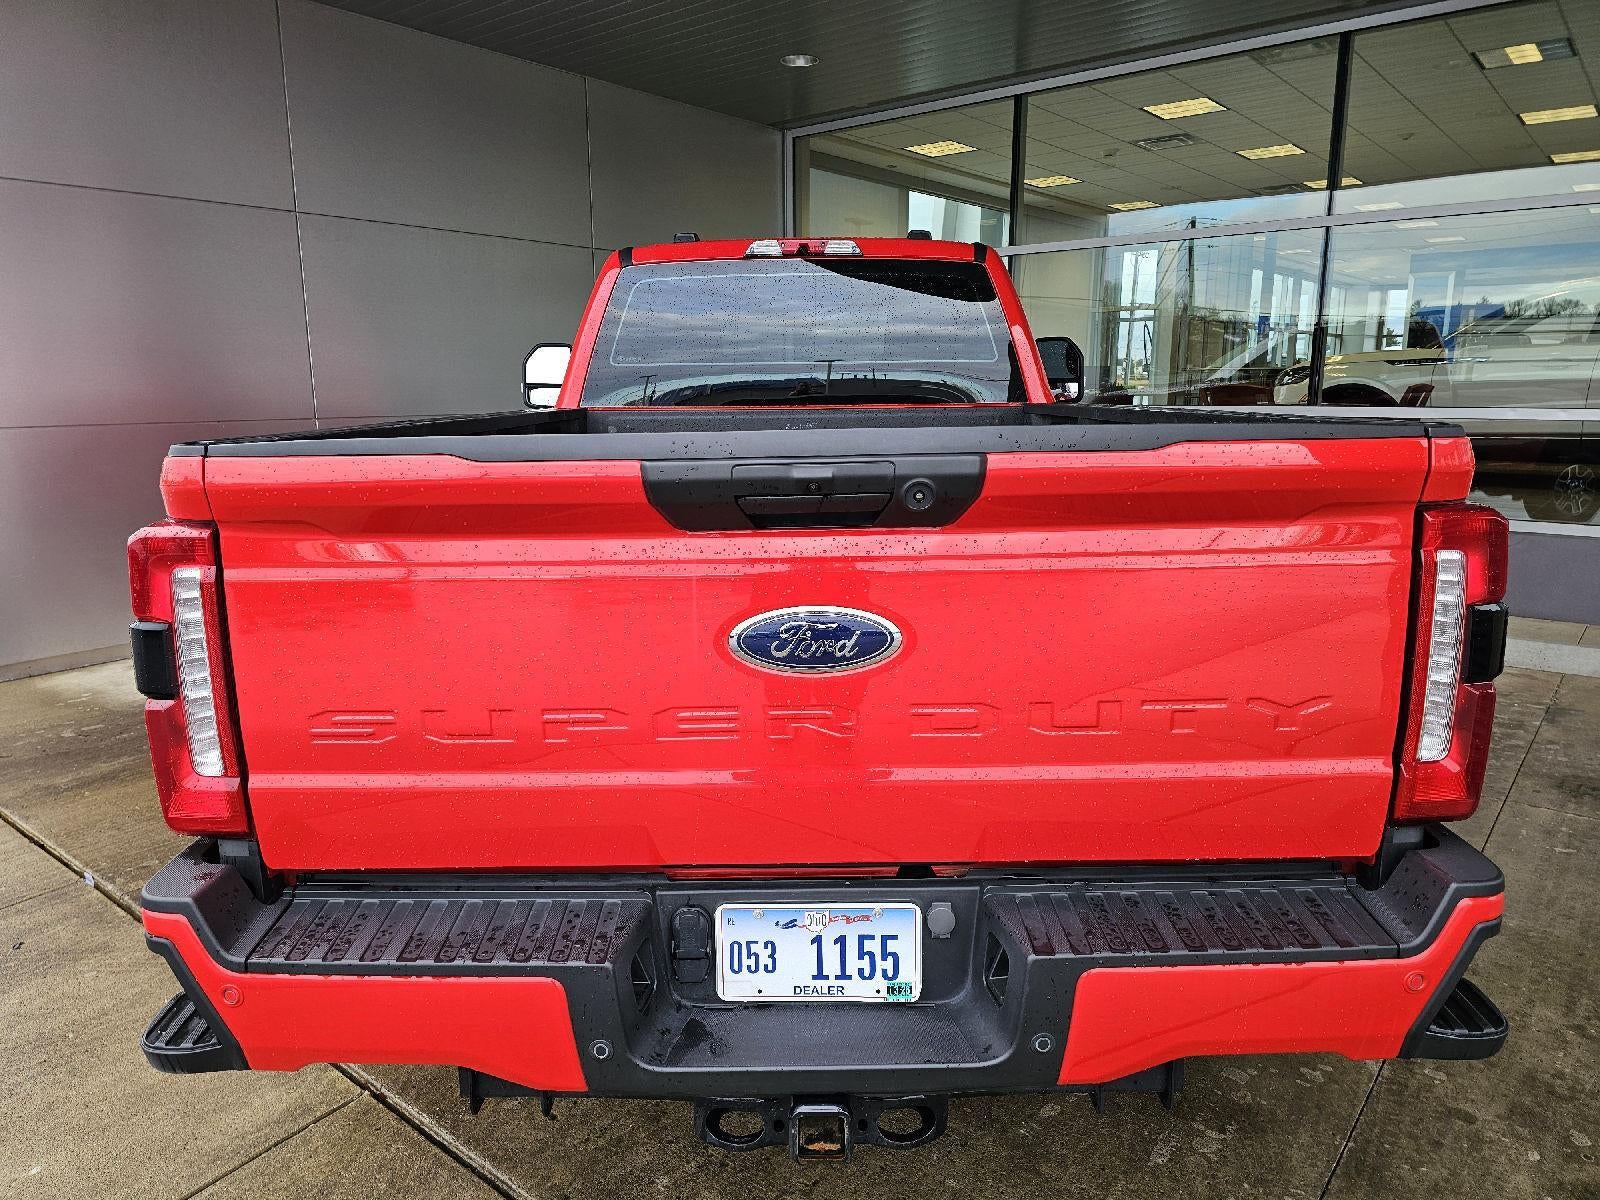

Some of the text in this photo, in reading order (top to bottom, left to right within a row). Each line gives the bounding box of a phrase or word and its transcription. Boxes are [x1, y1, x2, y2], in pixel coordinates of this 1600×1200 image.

[770, 621, 862, 658] Ford
[306, 694, 1334, 744] SUPER DUTY
[729, 934, 900, 981] 053 1155
[793, 985, 845, 996] DEALER
